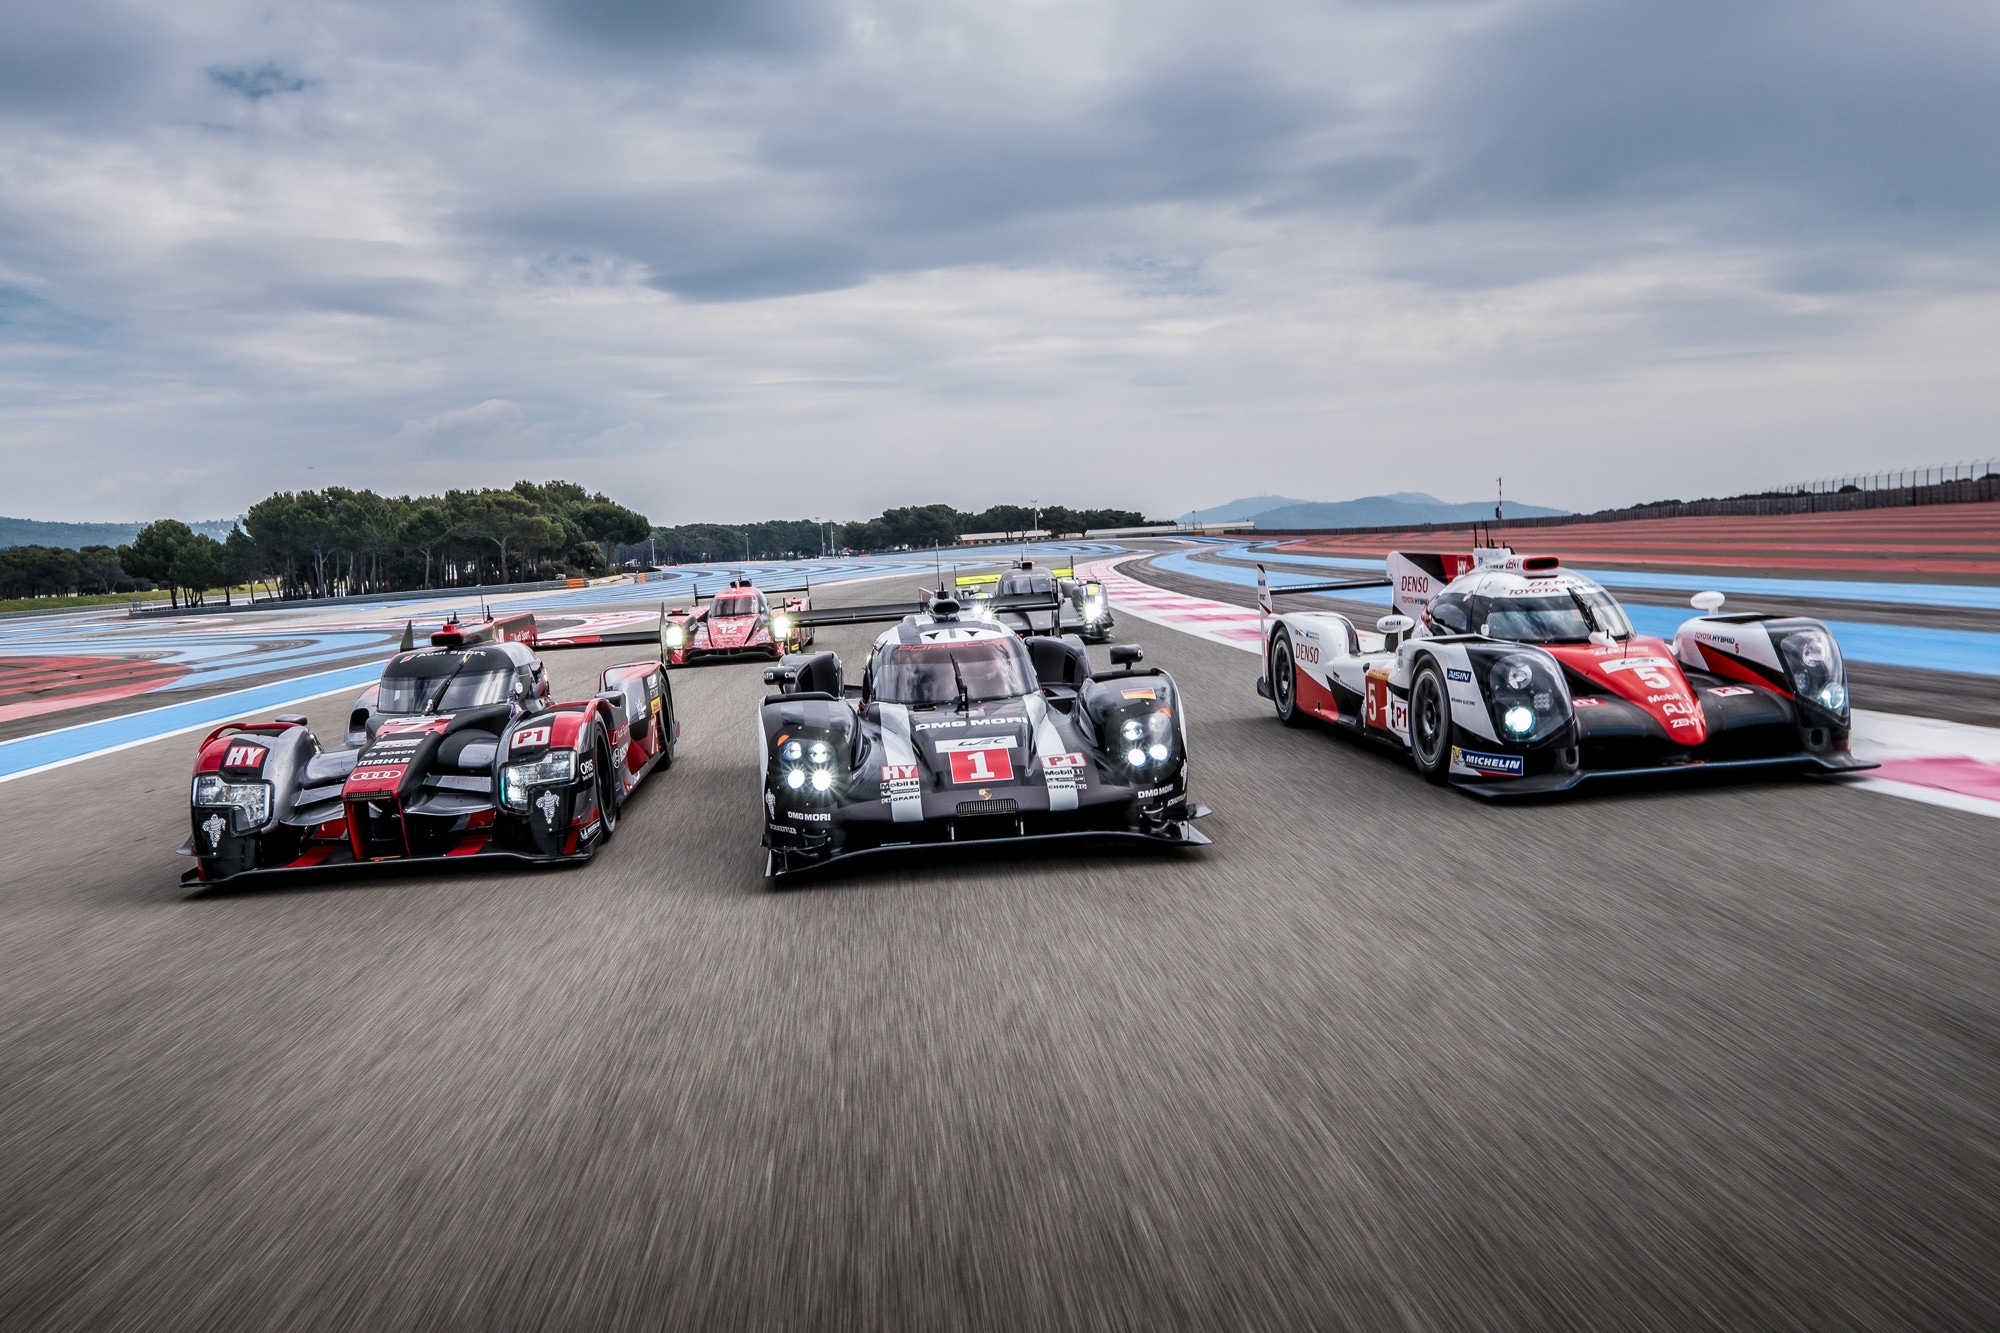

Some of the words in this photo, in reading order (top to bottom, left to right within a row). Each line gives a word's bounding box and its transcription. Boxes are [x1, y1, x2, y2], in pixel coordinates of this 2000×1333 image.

[1457, 561, 1467, 575] HY
[1401, 576, 1429, 593] DENSO
[1509, 588, 1560, 596] TOYOTA
[720, 625, 738, 634] 12
[1695, 632, 1712, 640] TOYOTA
[1295, 643, 1319, 664] DENSO
[1735, 643, 1740, 654] 5
[450, 650, 486, 659] Sport
[1448, 670, 1470, 681] AISIN
[1634, 667, 1671, 689] 5
[1368, 683, 1377, 721] 5
[1647, 693, 1681, 703] Mobil
[1396, 706, 1407, 728] P1
[915, 719, 967, 731] DMG
[970, 716, 1028, 727] MORI
[1671, 718, 1699, 728] ZENT
[518, 730, 543, 744] P1
[958, 737, 1007, 746] WEC
[225, 747, 265, 766] HY
[358, 758, 411, 766] MAHLE
[1048, 755, 1078, 766] P1
[1466, 755, 1521, 769] MICHELIN
[580, 759, 593, 774] ORIS
[967, 751, 995, 779] 1
[883, 766, 915, 779] HY
[1045, 768, 1073, 776] Mobil
[881, 781, 909, 789] Mobil
[1137, 790, 1158, 799] DMG
[1159, 783, 1174, 795] MORI
[881, 795, 920, 804] CHOPARD
[787, 811, 804, 820] DMG
[804, 813, 831, 821] MORI
